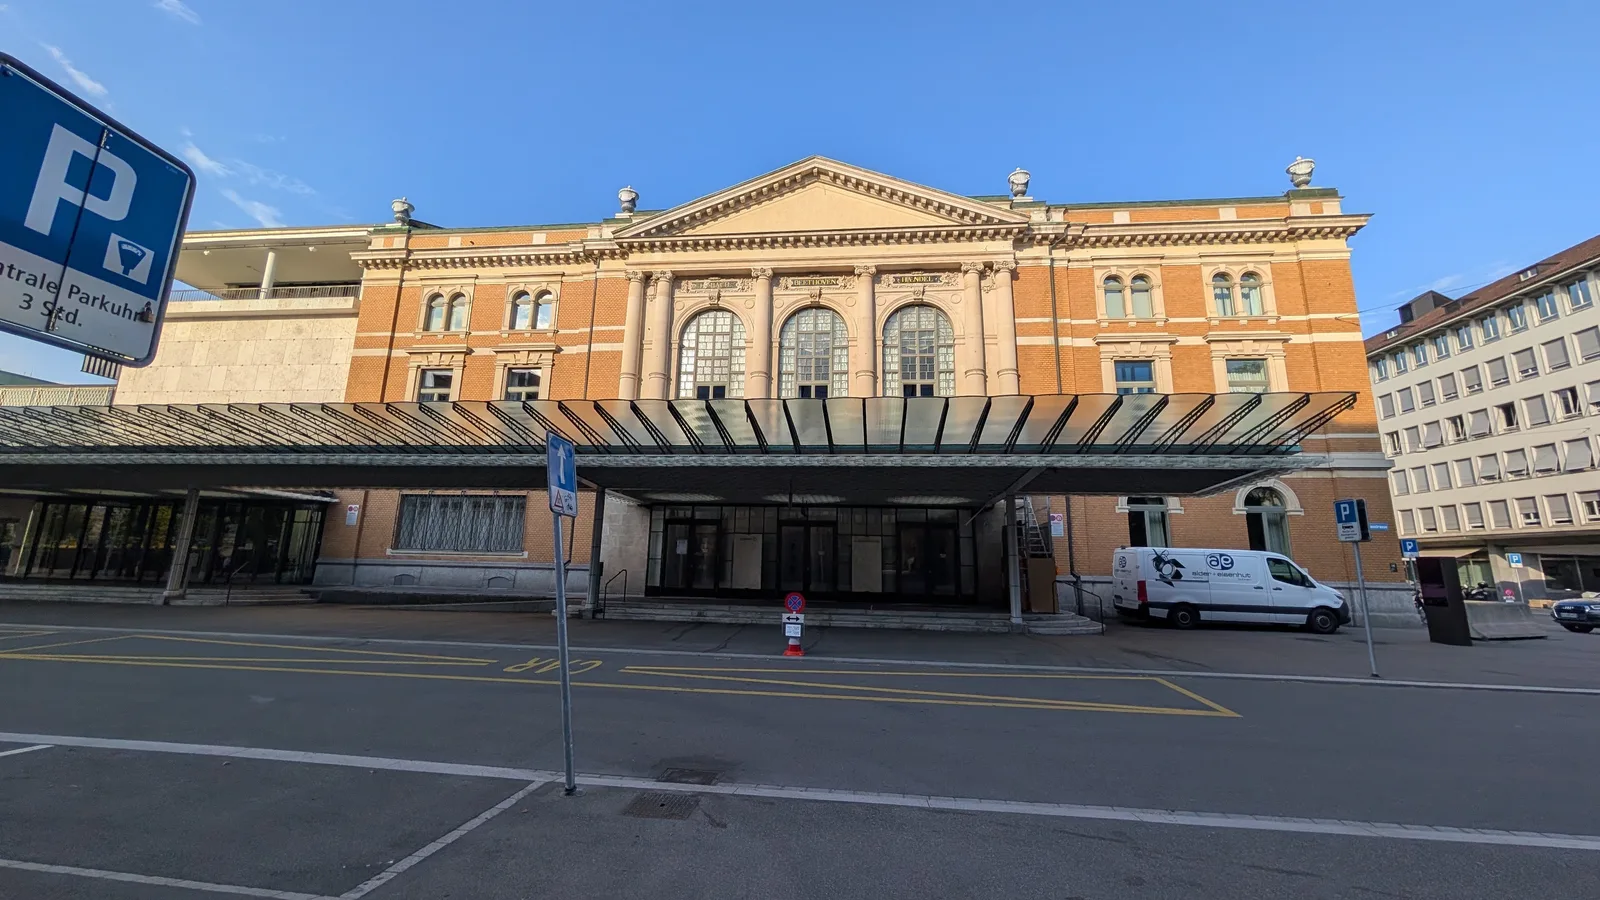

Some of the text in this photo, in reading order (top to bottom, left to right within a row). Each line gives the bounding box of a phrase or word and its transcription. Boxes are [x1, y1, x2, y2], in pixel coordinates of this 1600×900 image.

[24, 123, 138, 236] P
[794, 278, 837, 286] BEETHOVEN
[19, 293, 82, 327] 3 Std.
[68, 284, 140, 322] Parkuhr
[1340, 504, 1350, 521] P
[1406, 541, 1414, 551] P
[503, 657, 603, 675] CAR
